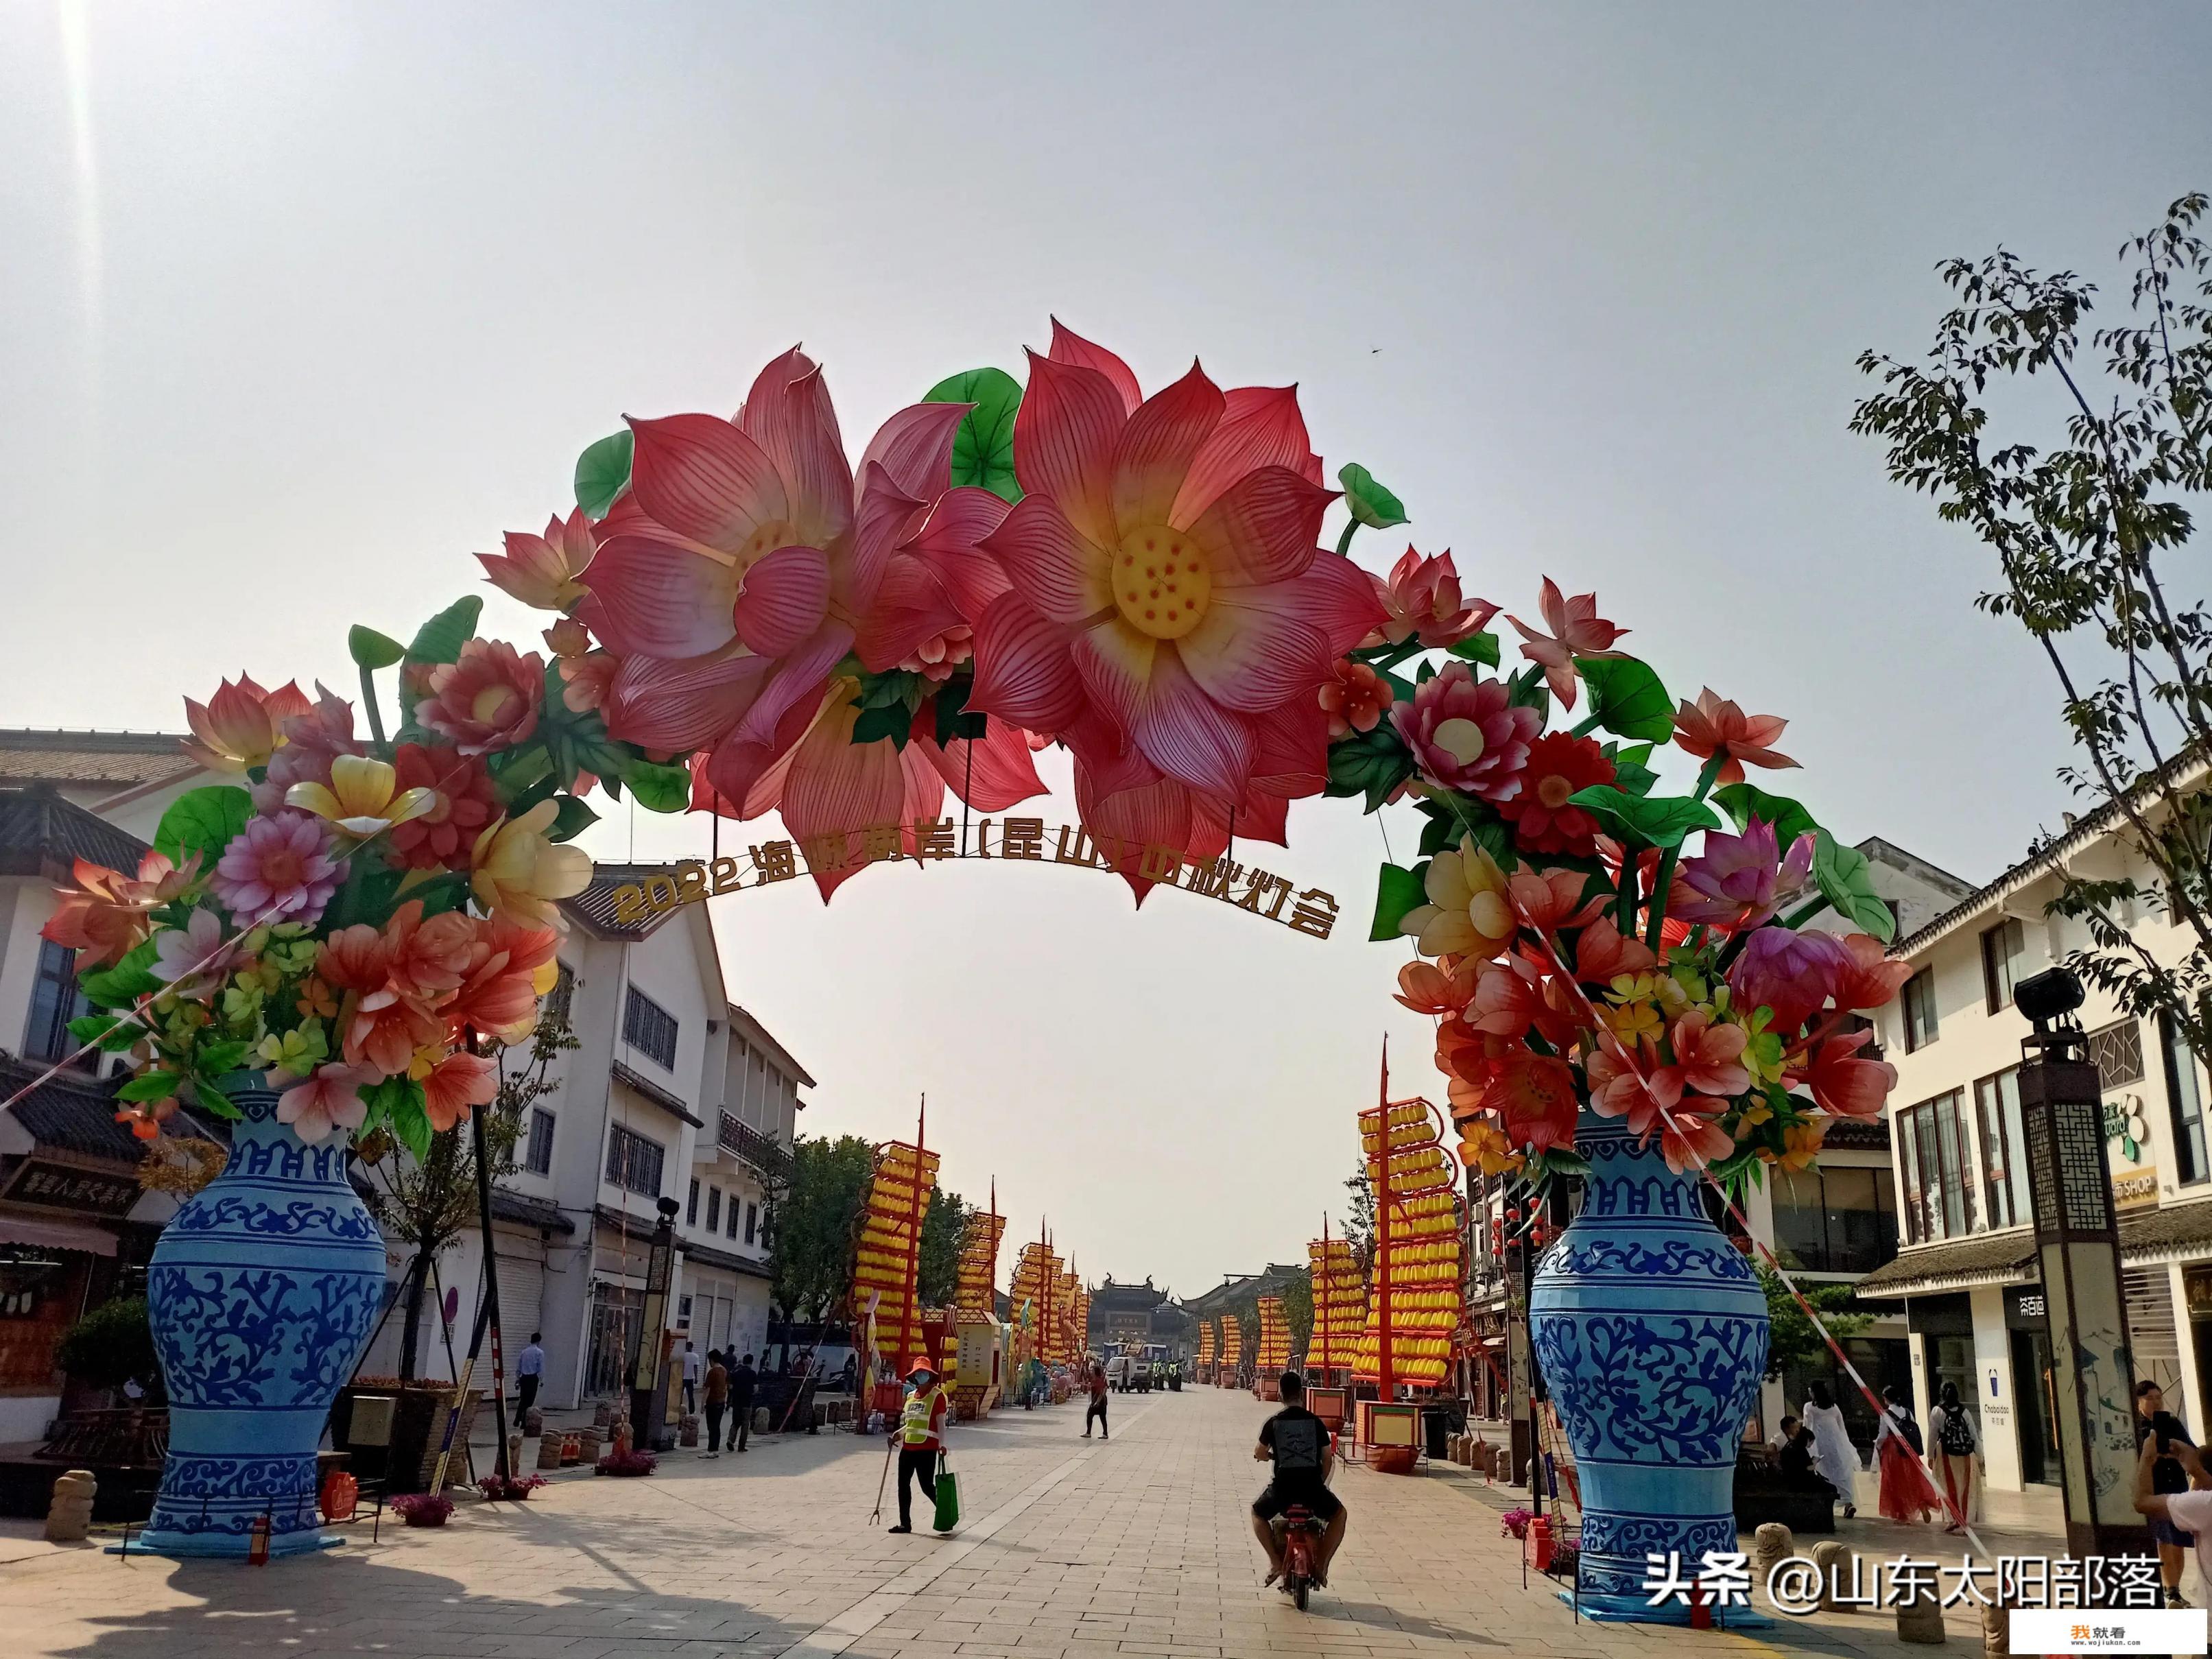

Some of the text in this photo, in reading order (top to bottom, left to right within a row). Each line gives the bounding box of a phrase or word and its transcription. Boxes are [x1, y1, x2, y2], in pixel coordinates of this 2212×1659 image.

[2124, 1176, 2151, 1197] SHOP
[2019, 1295, 2045, 1317] 茶百道
